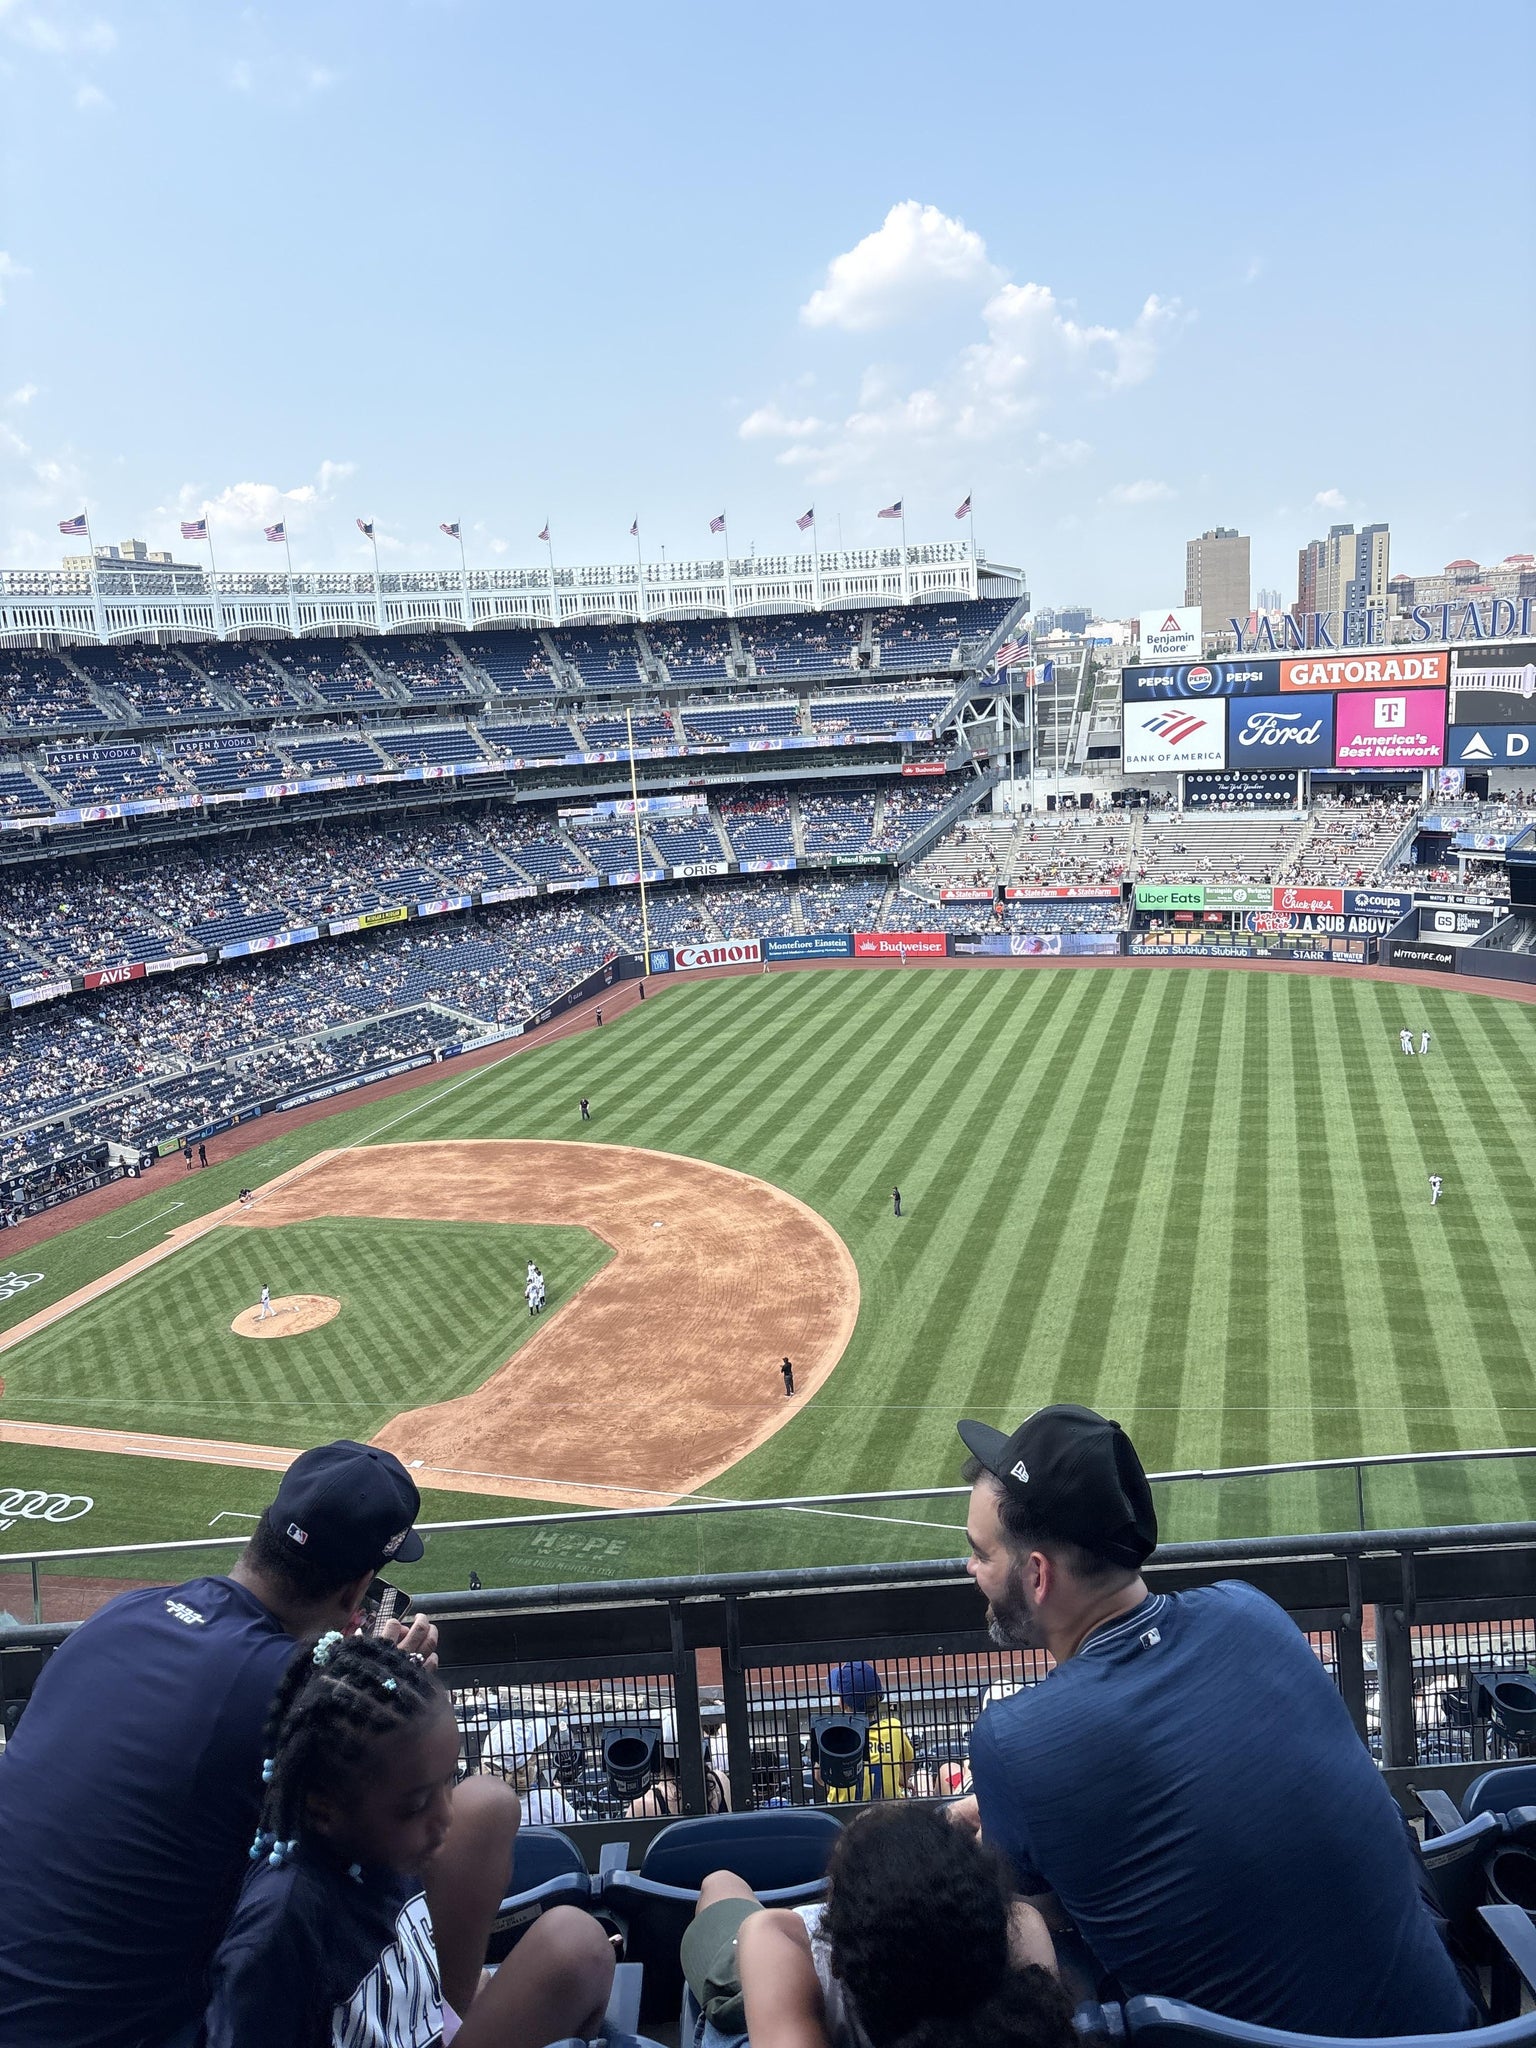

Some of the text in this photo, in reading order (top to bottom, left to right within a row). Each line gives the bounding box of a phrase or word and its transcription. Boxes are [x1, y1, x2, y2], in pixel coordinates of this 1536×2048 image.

[1228, 597, 1535, 652] YANKEE STADI
[1147, 633, 1195, 645] Benjamin
[1153, 644, 1187, 653] Moore
[1226, 671, 1263, 683] PEPSI
[1290, 657, 1439, 685] GATORADE
[1138, 676, 1174, 687] PEPSI
[1189, 675, 1211, 683] PEPSI
[1238, 712, 1323, 746] Ford
[179, 737, 253, 752] ASPEN VODKA
[1351, 734, 1428, 746] America's
[52, 748, 137, 763] ASPEN VODKA
[1339, 745, 1441, 757] Best Network
[1126, 752, 1222, 763] BANK OF AMERICA
[837, 855, 881, 864] Poland Spring
[684, 865, 718, 876] ORIS
[1139, 893, 1169, 904] Uber
[1171, 893, 1201, 904] Eats
[1282, 890, 1334, 911] Chick-fil-A
[1370, 896, 1401, 908] coupa
[1303, 916, 1313, 931] A
[1316, 916, 1345, 932] SUB
[1438, 916, 1452, 926] GS
[768, 938, 847, 950] Montefiore Einstein
[676, 944, 759, 967] Canon
[1132, 946, 1248, 957] StubHub StubHub StubHub
[1293, 950, 1325, 960] STARR
[1393, 949, 1453, 964] NITTOTIRE.COM
[99, 967, 132, 985] AVIS
[531, 1531, 627, 1555] HOPE
